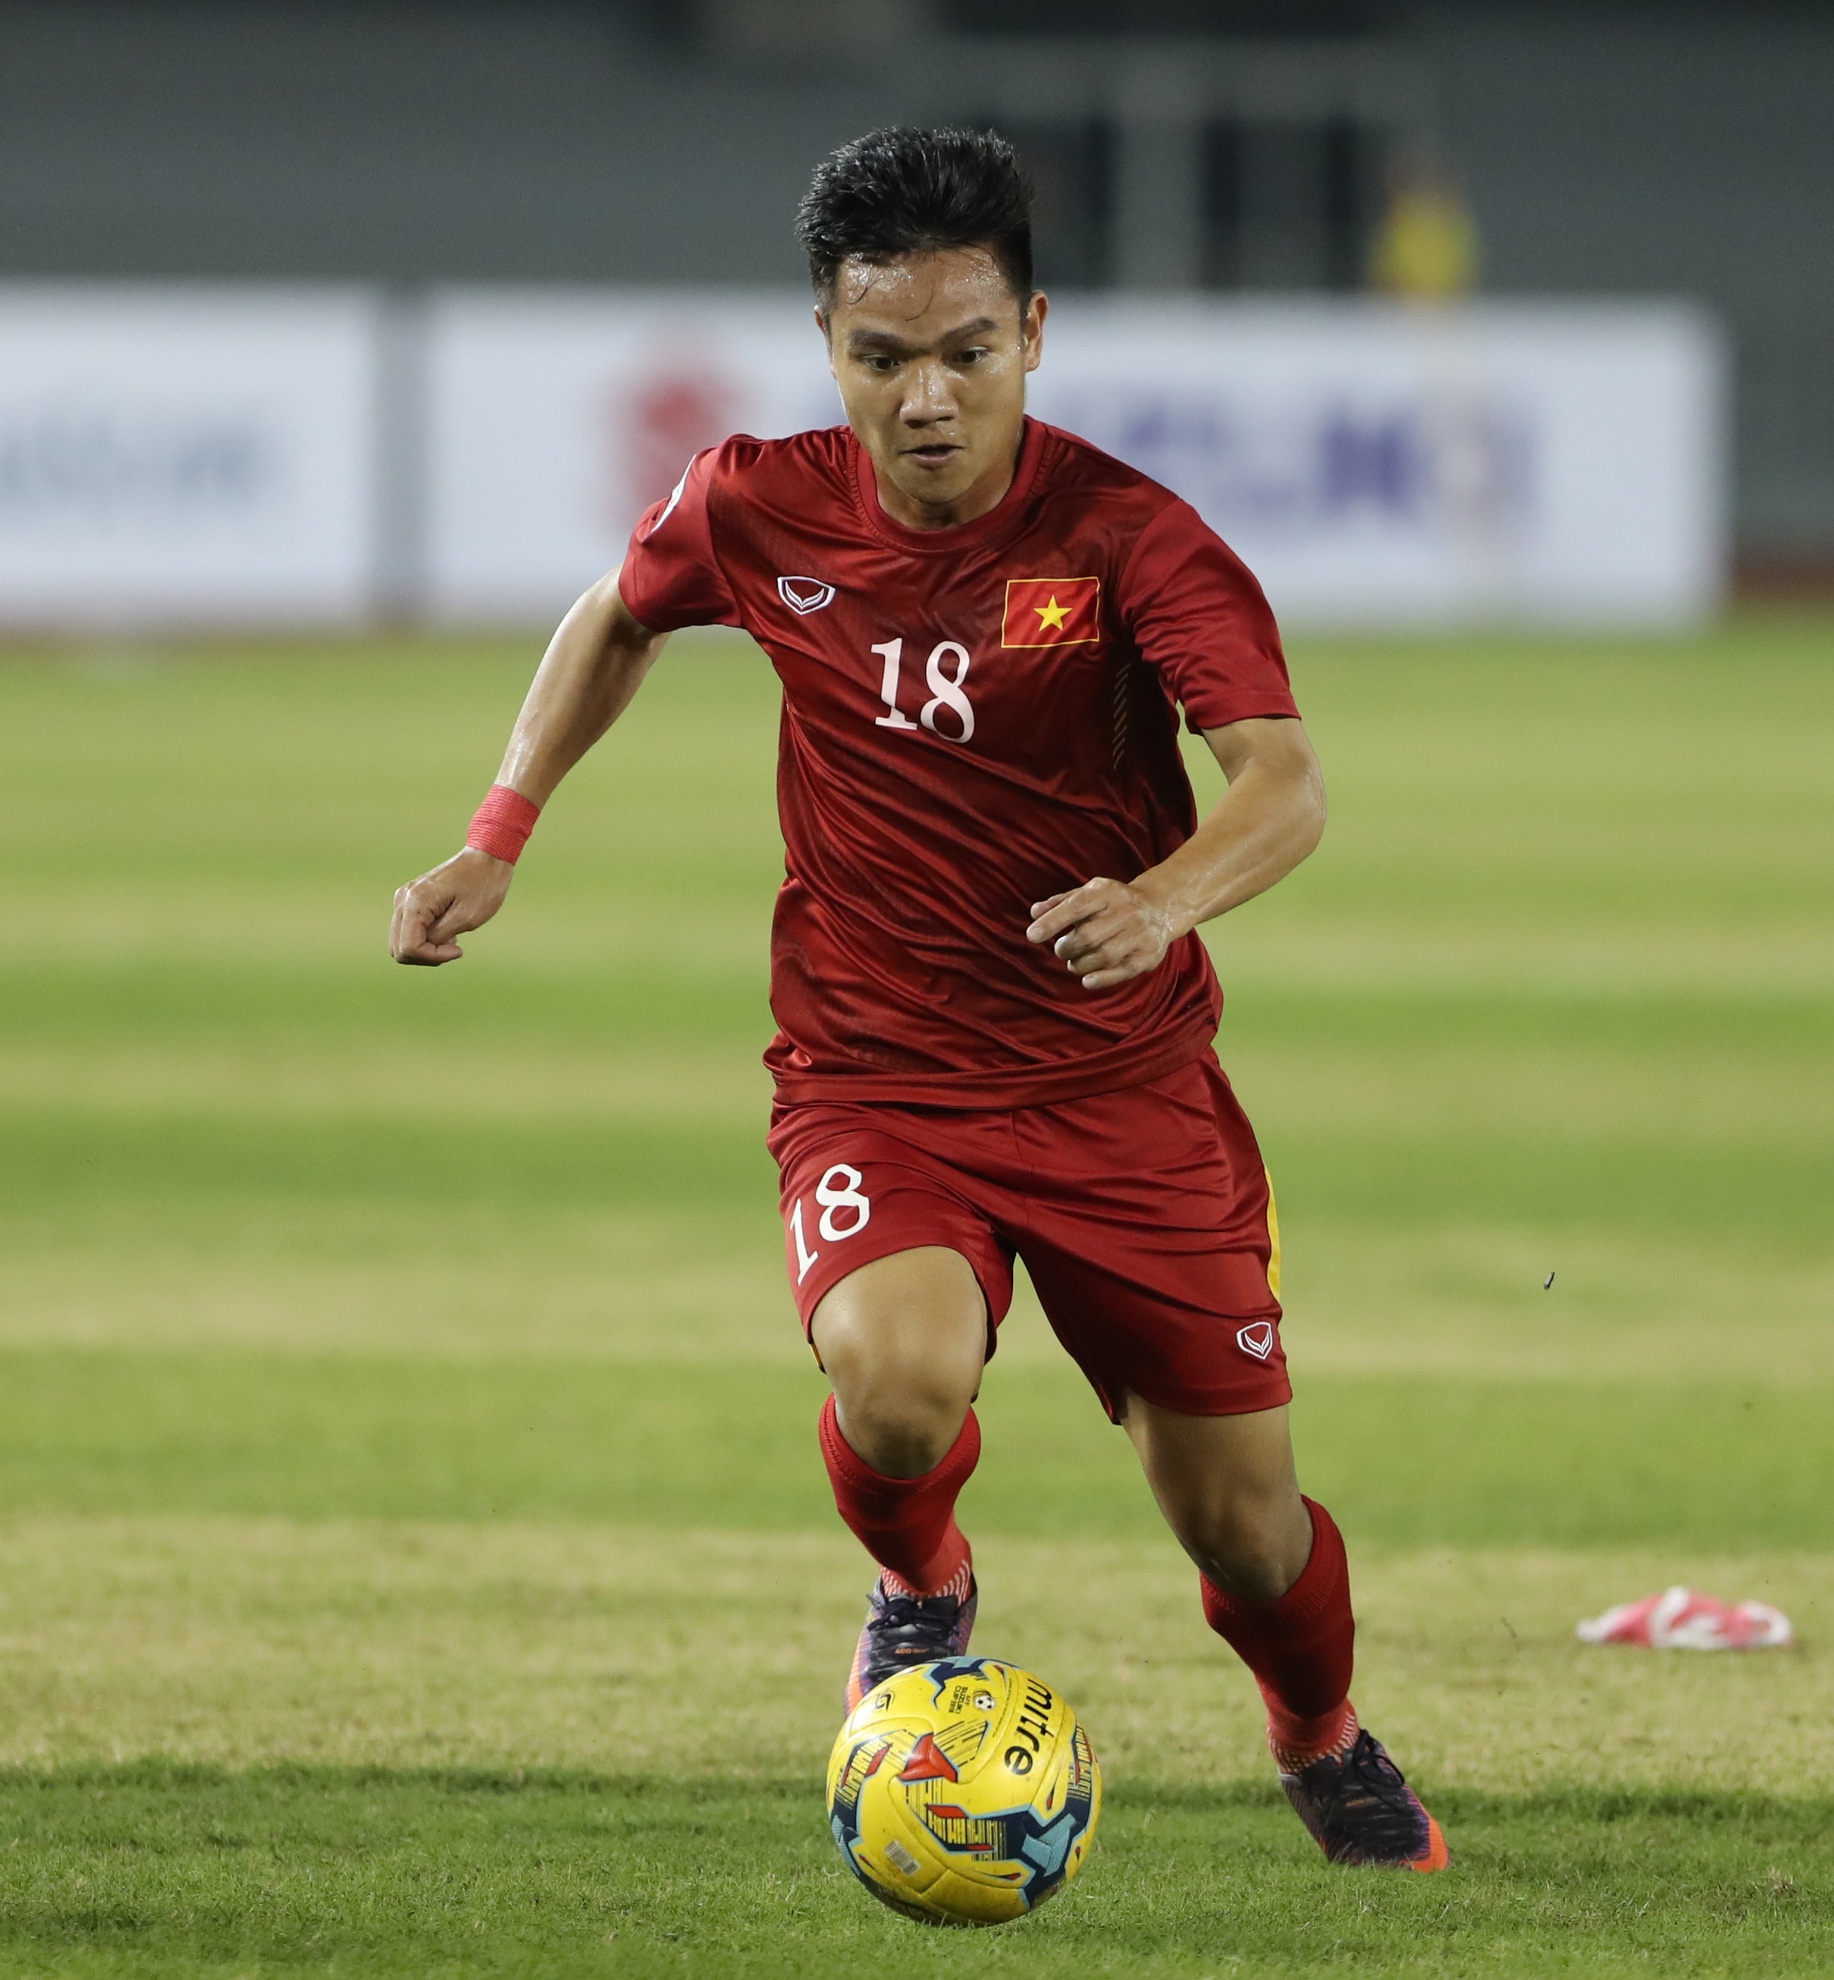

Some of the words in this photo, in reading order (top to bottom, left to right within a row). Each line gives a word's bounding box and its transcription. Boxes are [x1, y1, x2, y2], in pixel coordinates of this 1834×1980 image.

[871, 637, 975, 743] 18
[789, 1163, 871, 1286] 18
[1004, 1678, 1055, 1776] mitre
